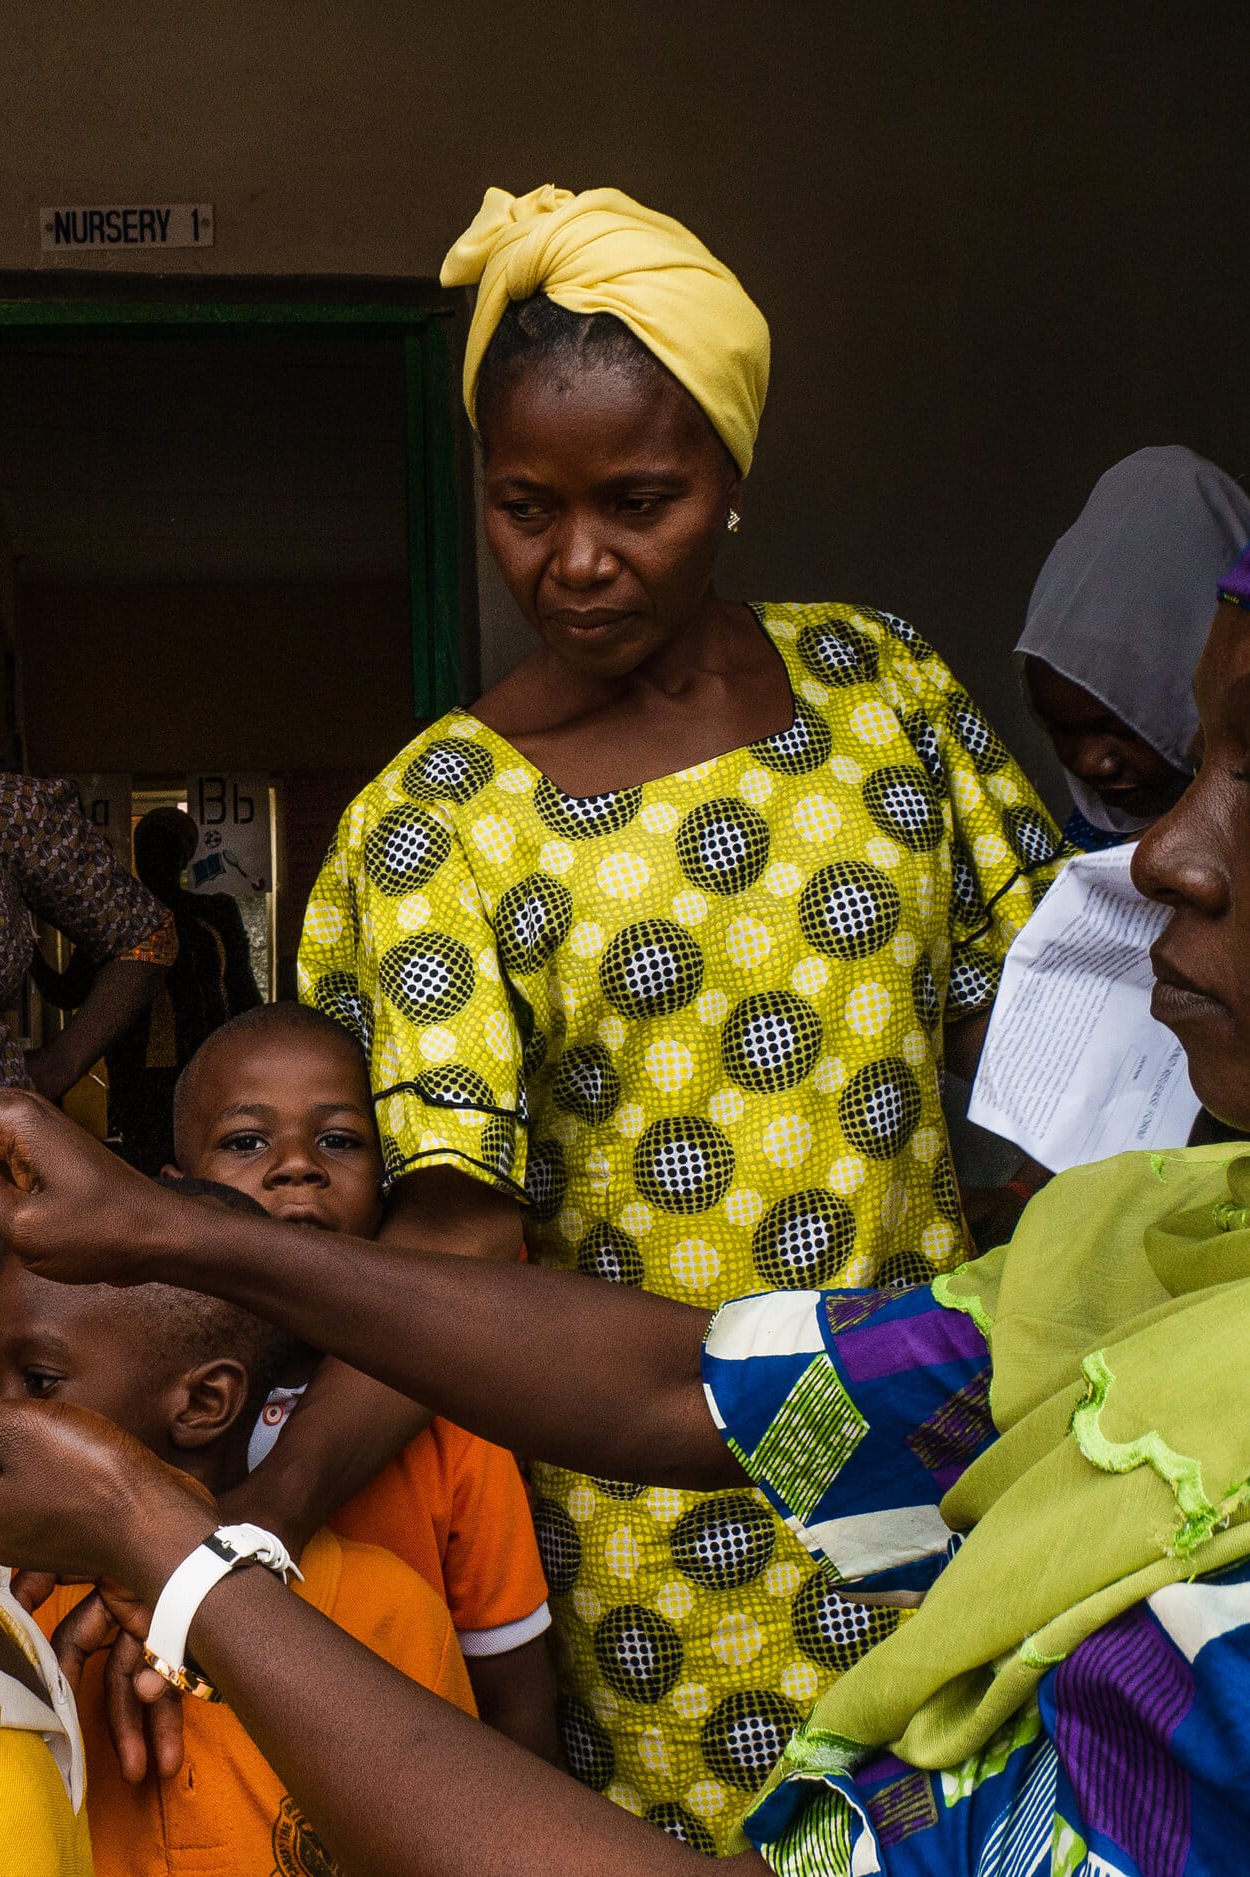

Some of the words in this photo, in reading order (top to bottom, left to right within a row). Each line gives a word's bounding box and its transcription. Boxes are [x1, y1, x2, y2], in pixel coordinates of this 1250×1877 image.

[54, 208, 171, 244] NURSERY
[191, 208, 200, 242] 1
[199, 777, 255, 825] Bb
